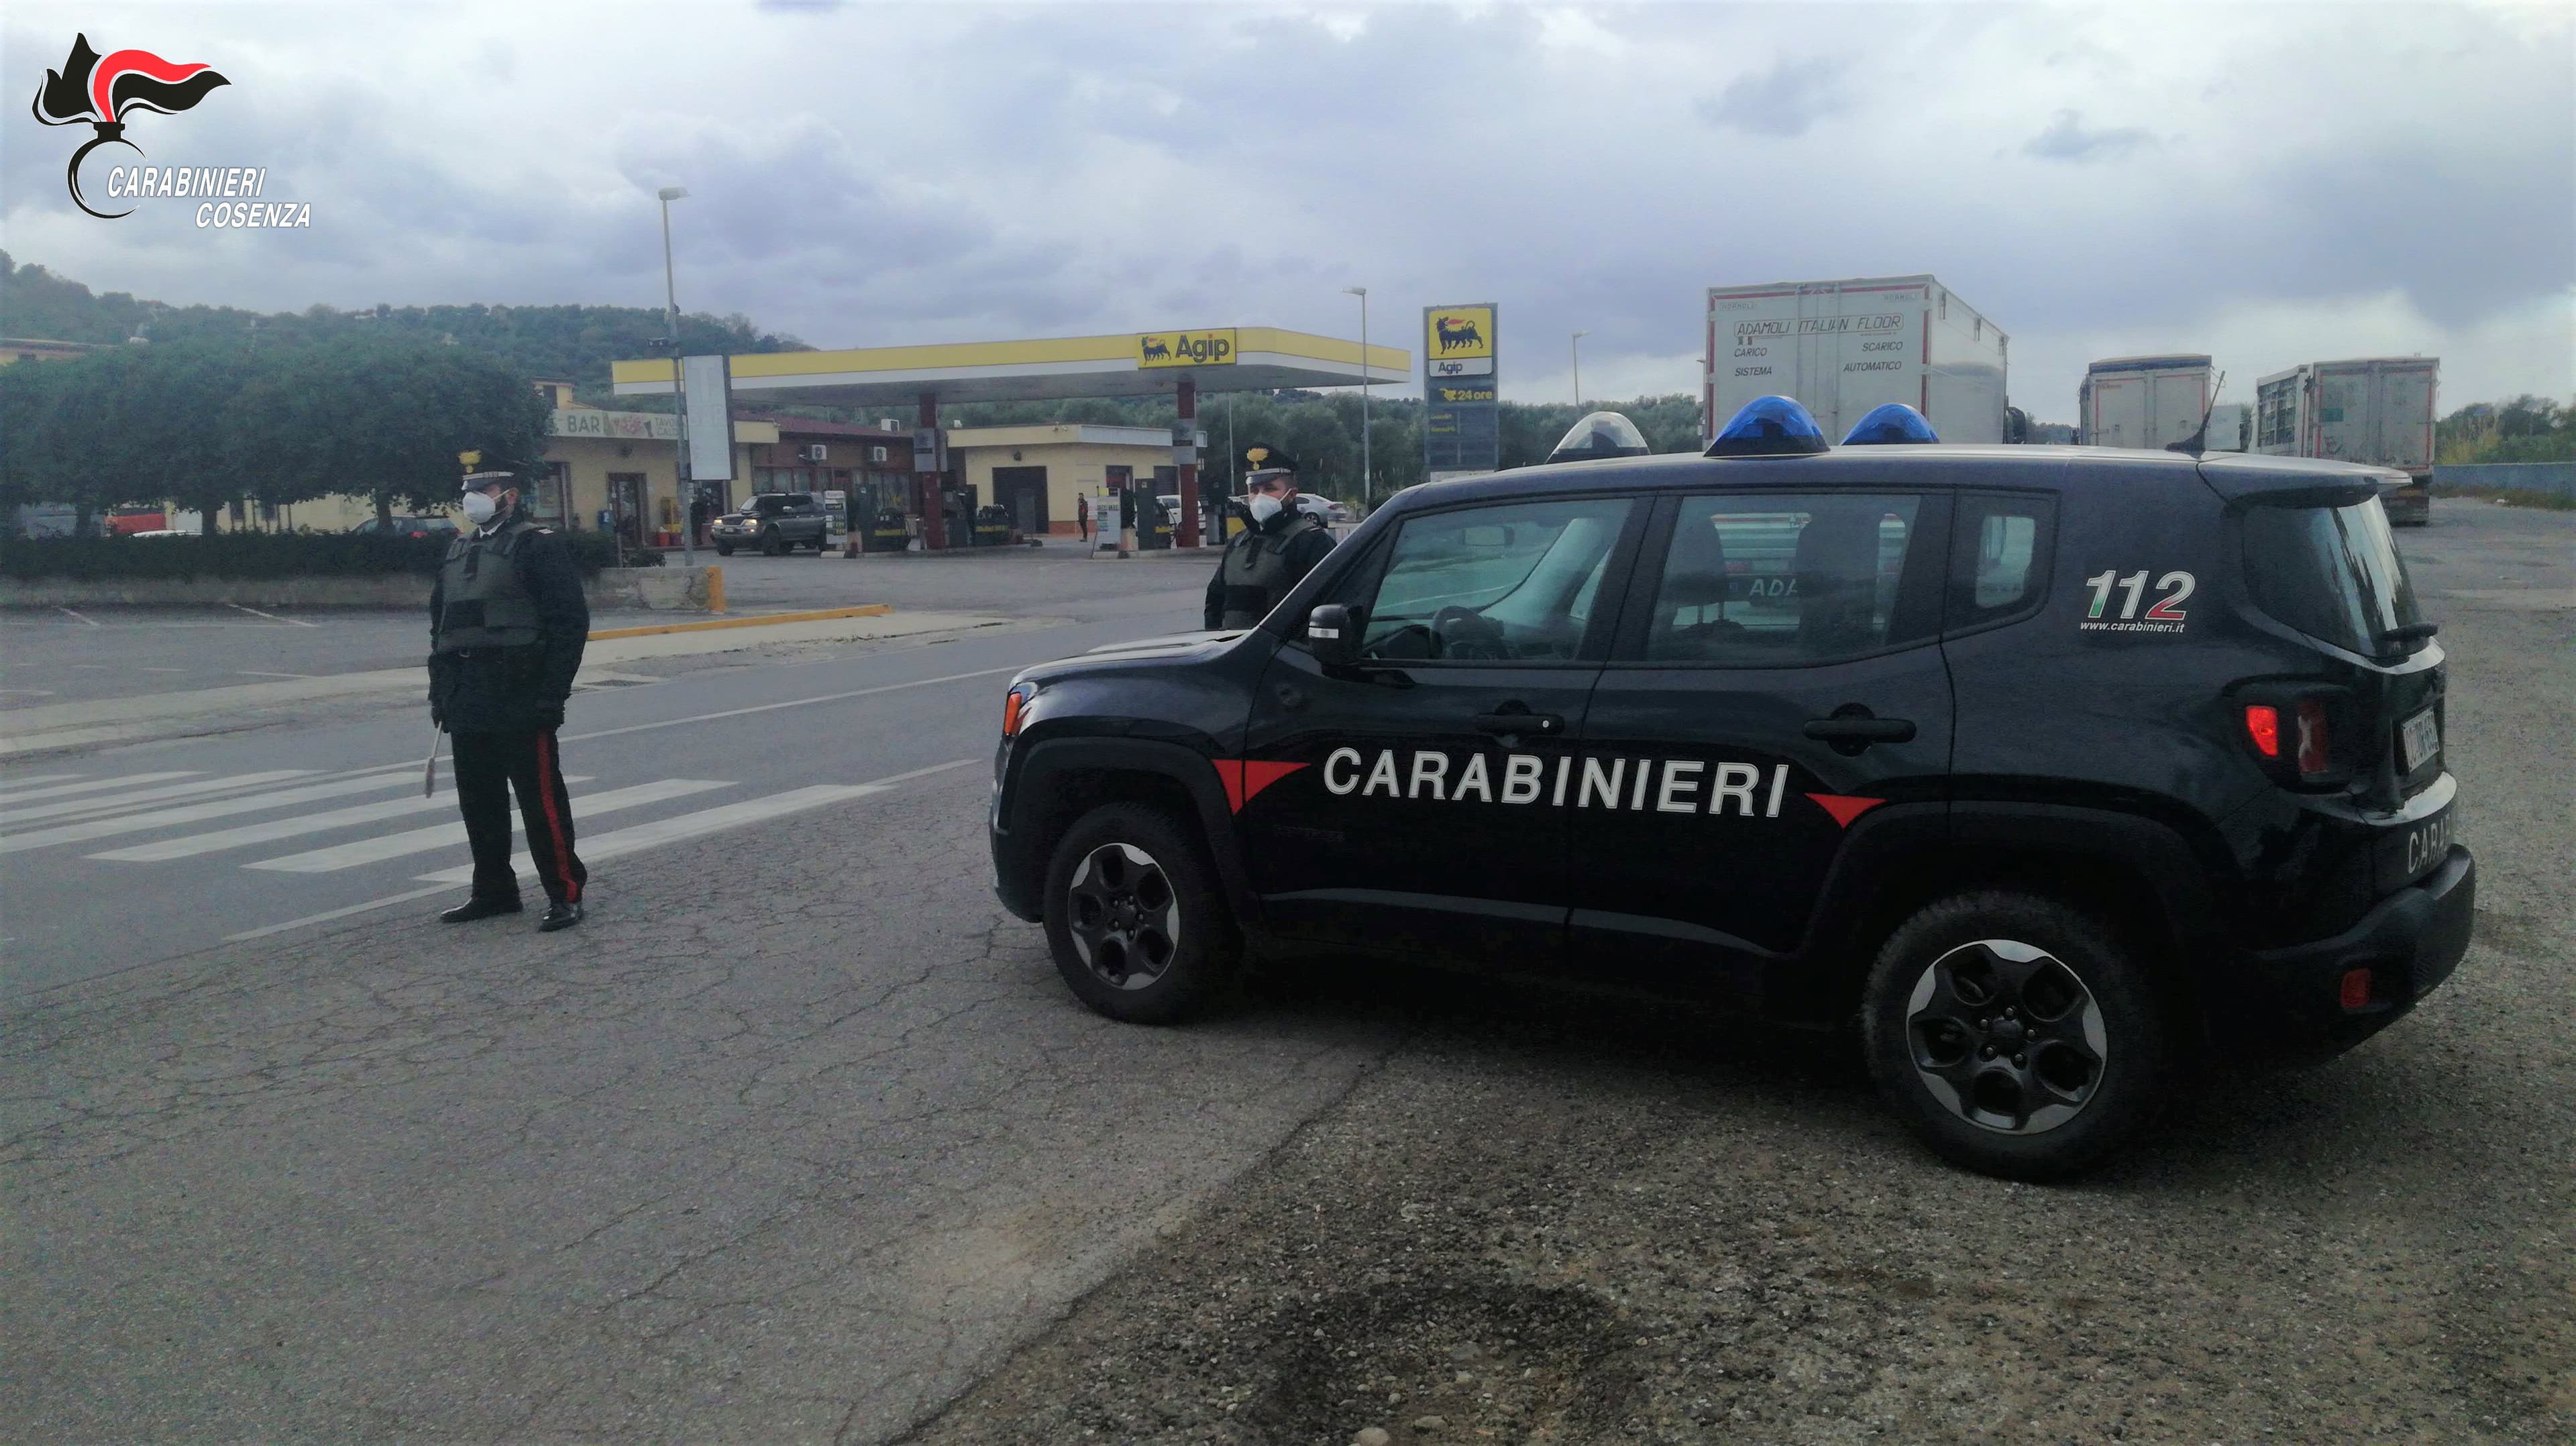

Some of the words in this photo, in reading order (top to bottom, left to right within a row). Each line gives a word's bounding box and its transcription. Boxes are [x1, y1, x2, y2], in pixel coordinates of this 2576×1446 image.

[1737, 321, 1791, 335] ADAMOLI
[1798, 318, 1849, 333] ITALIAN
[1857, 315, 1901, 330] FLOOR
[1175, 333, 1230, 363] Agip
[1734, 347, 1768, 357] CARICO
[1862, 341, 1904, 352] SCARICO
[1438, 362, 1463, 374] Agip
[1735, 366, 1772, 377] SISTEMA
[1843, 361, 1902, 372] AUTOMATICO
[1458, 389, 1473, 401] 24
[1474, 391, 1493, 400] ore
[567, 414, 601, 433] BAR
[2086, 570, 2196, 621] 112
[2080, 621, 2186, 633] www.carabinieri.it
[1323, 747, 1790, 818] CARABINIERI
